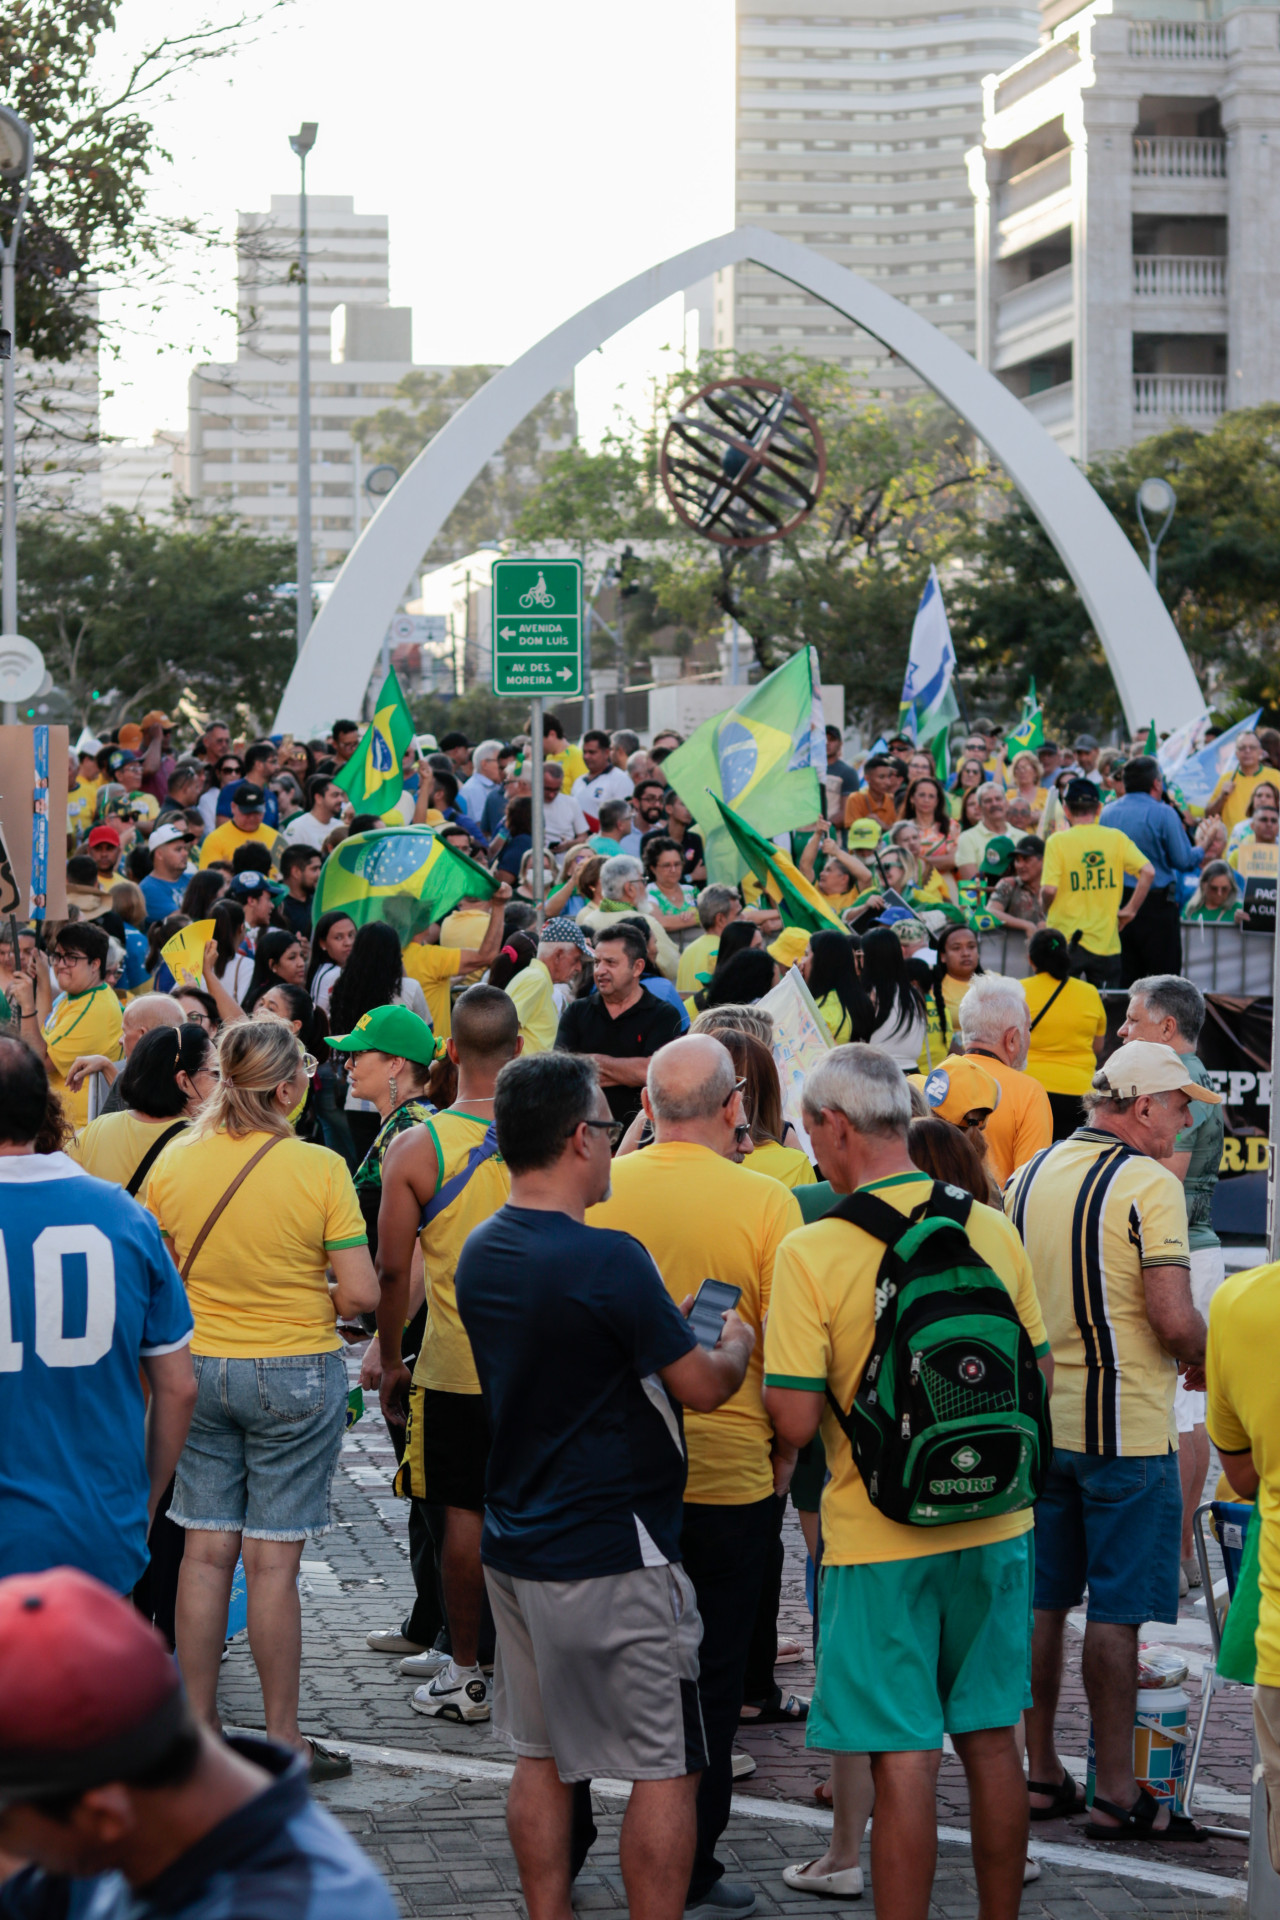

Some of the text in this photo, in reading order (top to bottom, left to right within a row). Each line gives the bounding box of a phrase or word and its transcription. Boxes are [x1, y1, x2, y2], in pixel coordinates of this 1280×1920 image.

[519, 624, 562, 633] AVENIDA
[519, 637, 543, 645] DOM
[512, 663, 552, 672] AV. DES.
[506, 676, 553, 685] MOREIRA
[1070, 868, 1117, 892] D.P.F.L
[926, 1075, 948, 1100] 22
[957, 1451, 975, 1467] S
[929, 1476, 996, 1495] SPORT
